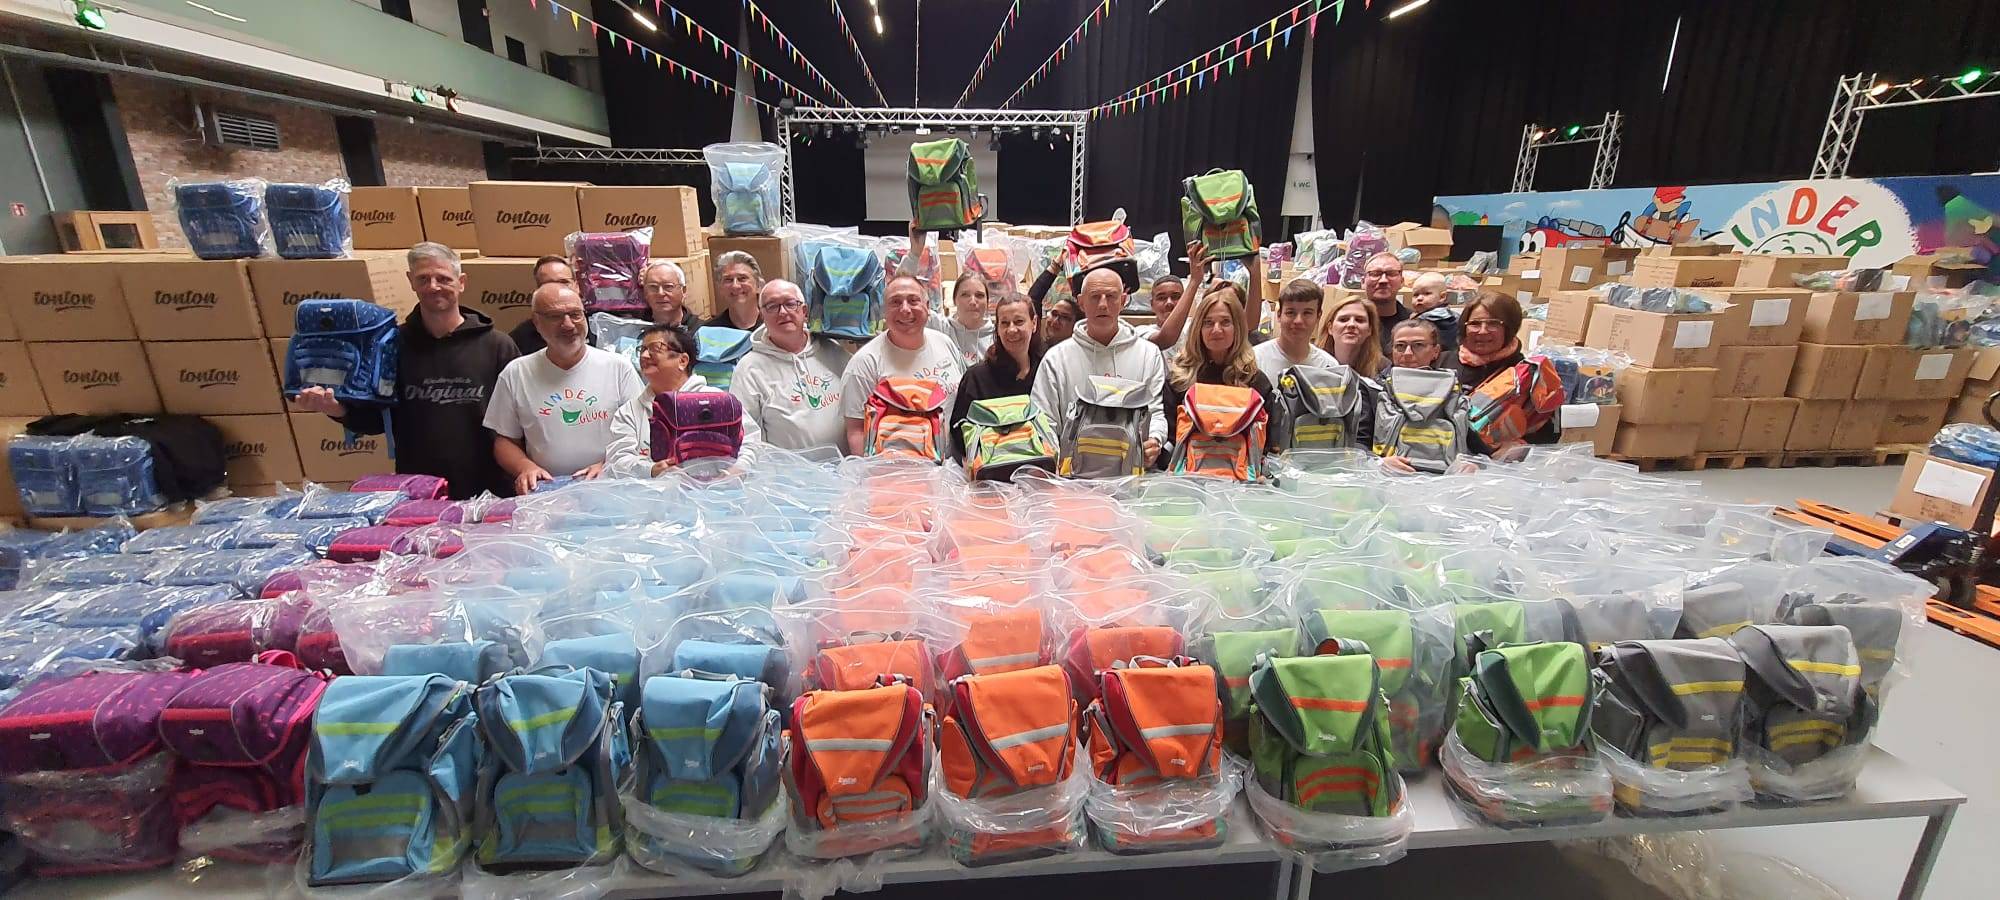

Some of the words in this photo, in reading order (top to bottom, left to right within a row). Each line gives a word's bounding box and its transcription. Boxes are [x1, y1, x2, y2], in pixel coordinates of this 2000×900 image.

[350, 209, 396, 222] tonton
[442, 209, 473, 222] tont
[496, 210, 551, 225] tonton
[605, 212, 658, 227] tonton
[1731, 187, 1881, 257] INDER
[154, 290, 218, 306] tonton
[63, 369, 121, 384] tonton
[179, 369, 240, 384] tonton
[405, 384, 485, 402] Original
[538, 388, 598, 416] KINDER
[320, 437, 379, 452] tonon
